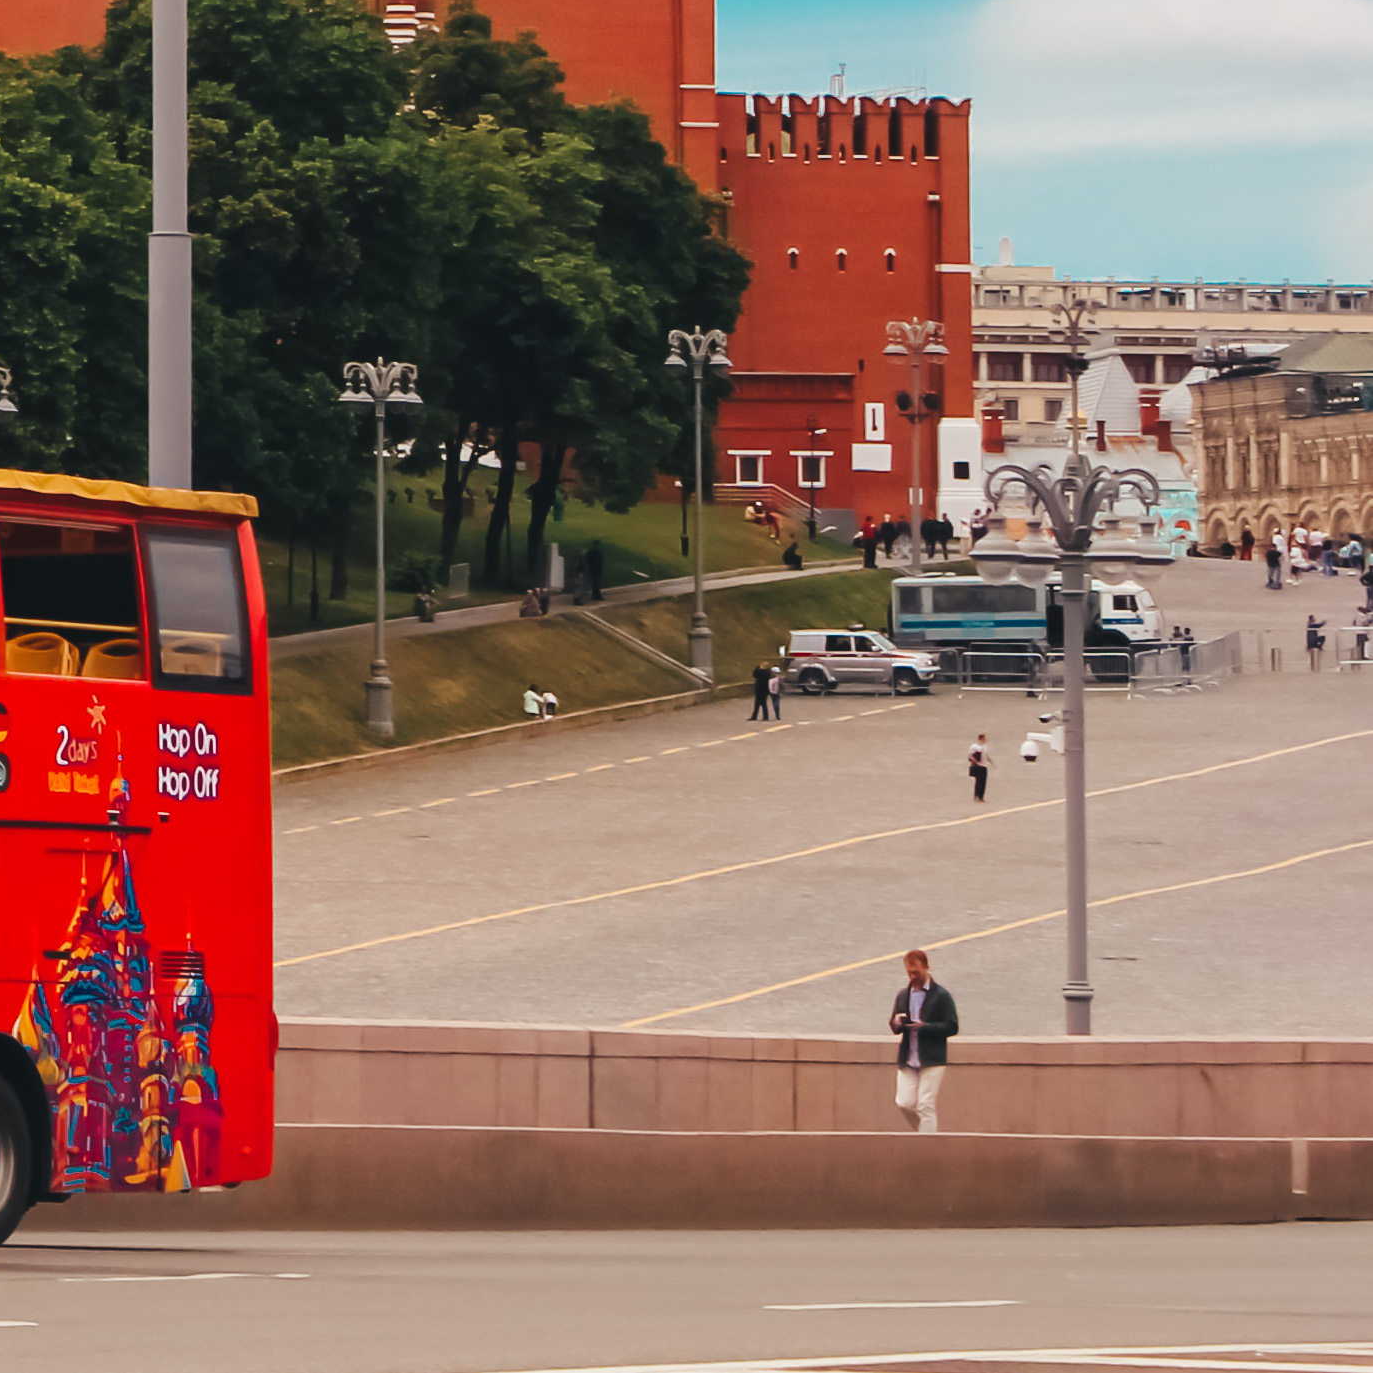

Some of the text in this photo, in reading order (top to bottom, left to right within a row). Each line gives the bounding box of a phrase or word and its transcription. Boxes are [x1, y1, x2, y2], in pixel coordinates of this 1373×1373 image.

[56, 725, 98, 765] 2 days
[158, 722, 217, 758] Hop On
[158, 765, 220, 801] Hop Off
